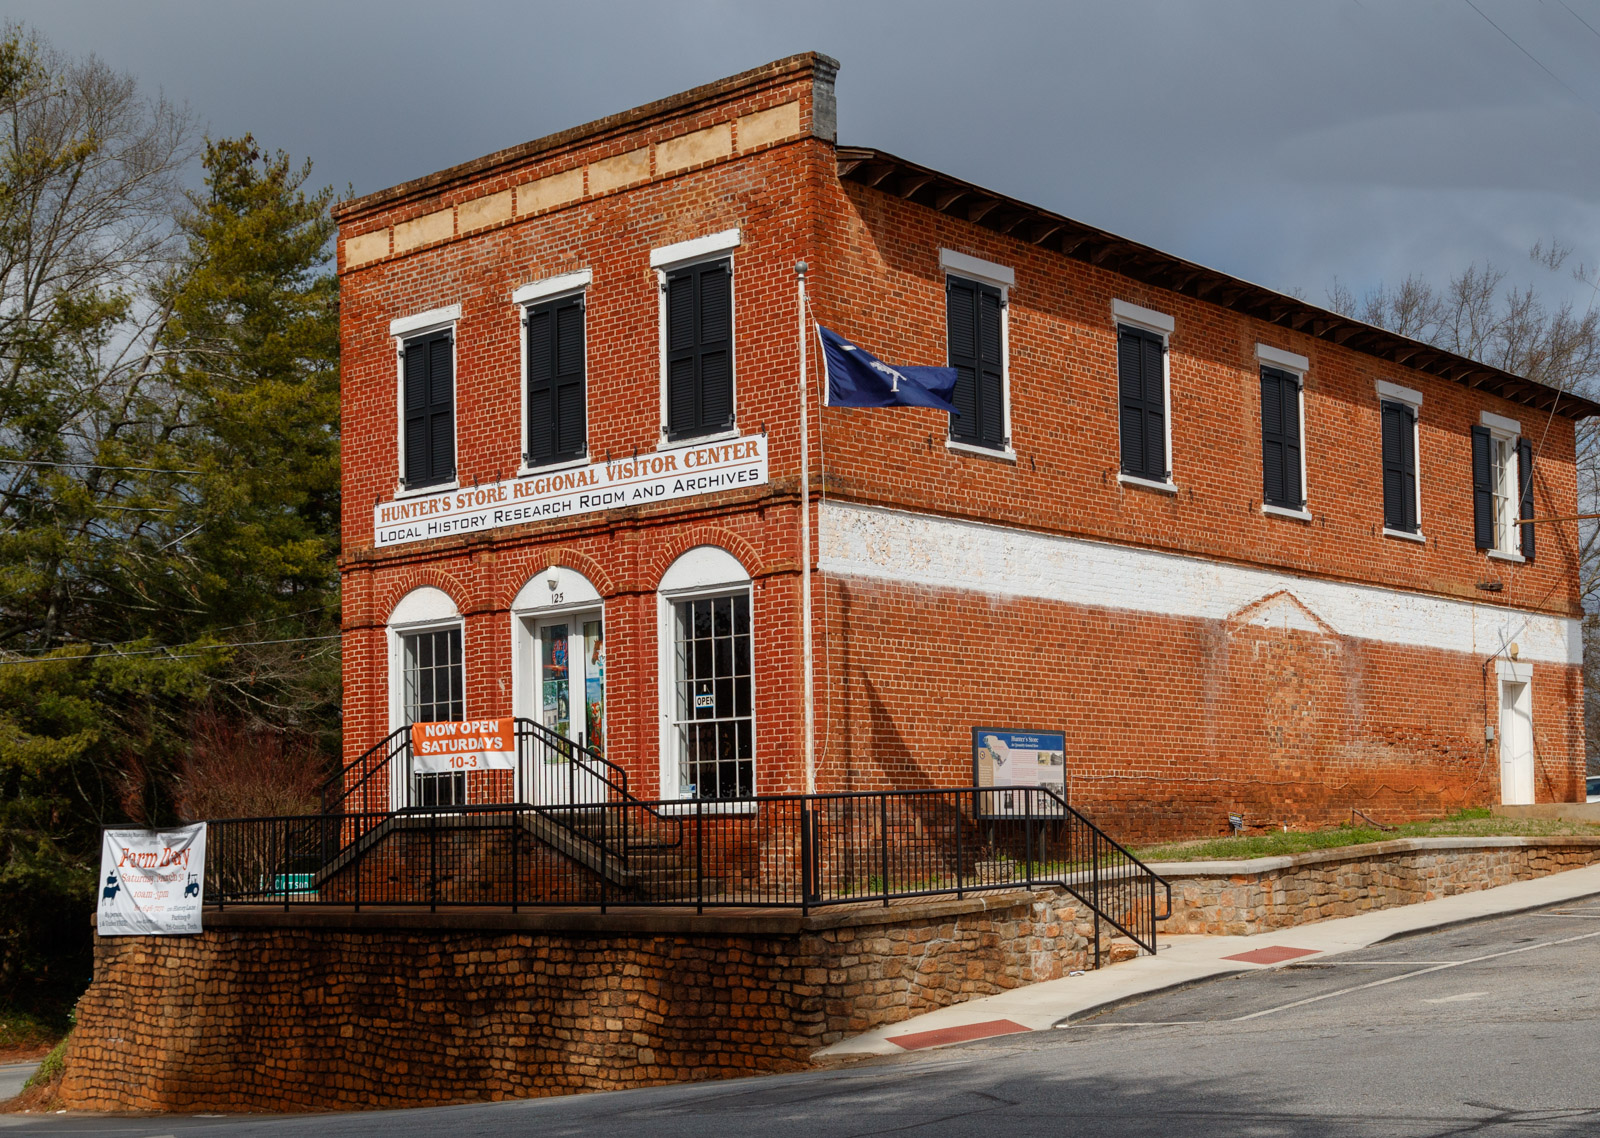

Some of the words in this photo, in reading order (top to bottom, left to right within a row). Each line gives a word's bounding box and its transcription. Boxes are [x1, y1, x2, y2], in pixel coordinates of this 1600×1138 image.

[381, 496, 451, 523] HUNTER'S
[456, 485, 508, 509] STORE
[513, 468, 599, 499] REGIONAL
[605, 455, 678, 482] VISITOR
[684, 440, 760, 468] CENTER
[380, 527, 422, 543] LOCAL
[428, 515, 487, 535] HISTORY
[494, 500, 572, 523] RESEARCH
[580, 490, 625, 509] ROOM
[632, 484, 665, 500] AND
[673, 468, 759, 493] ARCHIVES
[551, 592, 564, 604] 125
[697, 697, 714, 706] OPEN
[425, 722, 457, 737] NOW
[460, 720, 499, 734] OPEN
[421, 737, 503, 754] SATURDAYS
[449, 755, 477, 768] 10-3
[117, 847, 158, 869] Farm
[160, 847, 191, 871] Day
